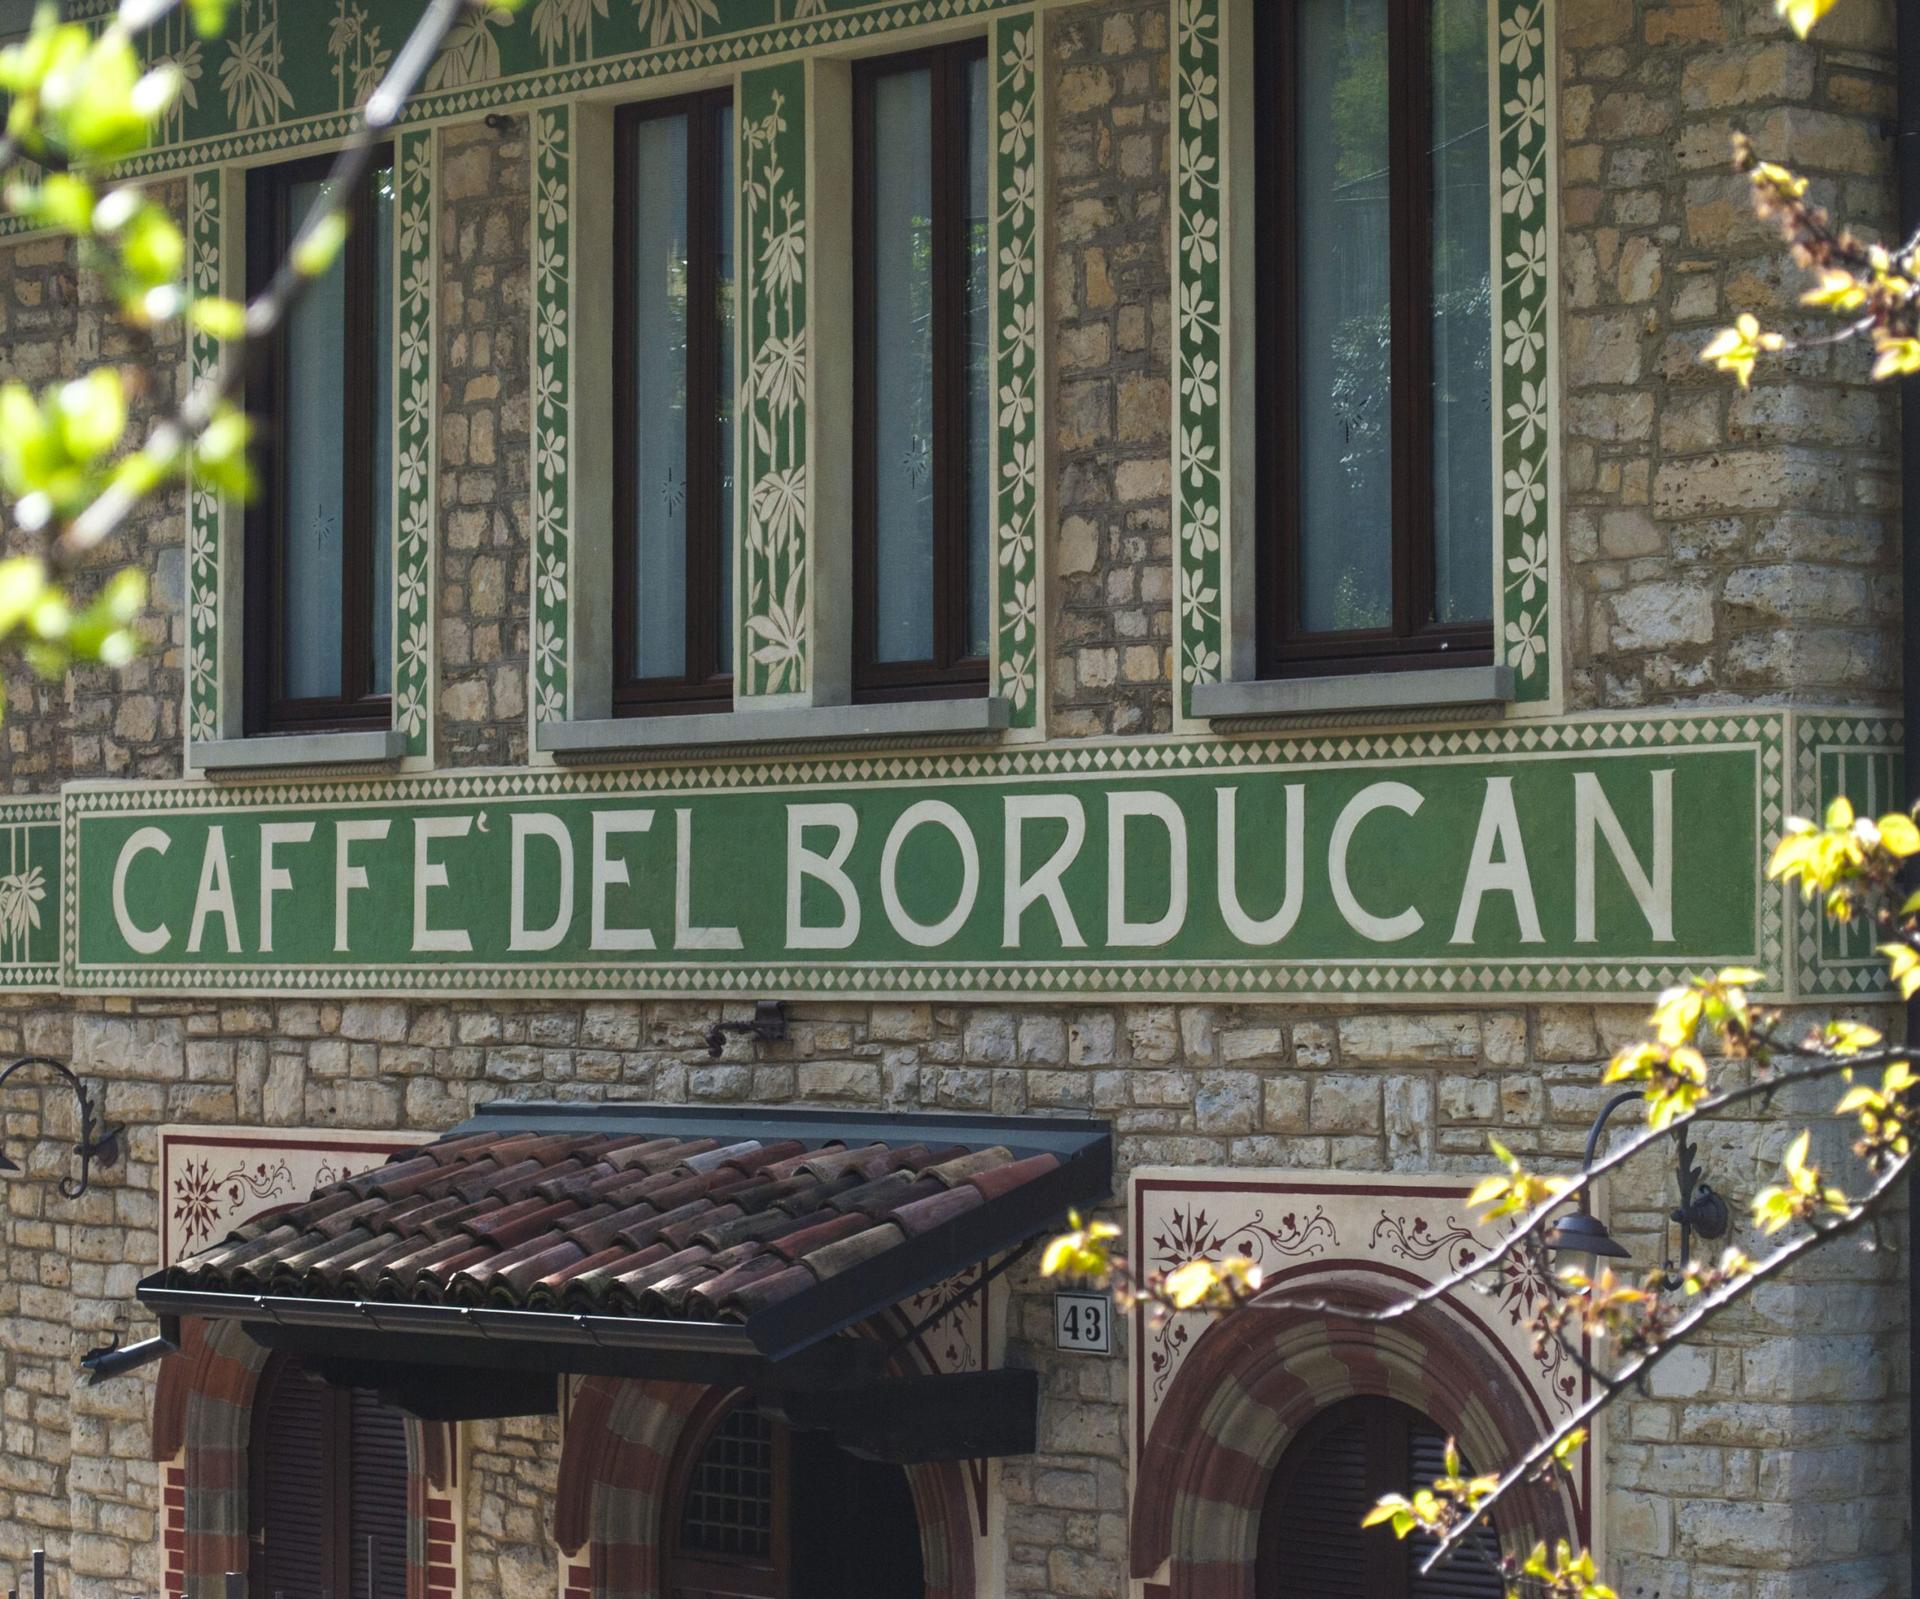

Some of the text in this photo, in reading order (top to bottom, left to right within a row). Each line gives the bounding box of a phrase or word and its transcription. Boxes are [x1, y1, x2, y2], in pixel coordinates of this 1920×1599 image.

[506, 808, 744, 952] DEL
[783, 768, 1676, 951] BORDUCAN
[1063, 1305, 1101, 1342] 43
